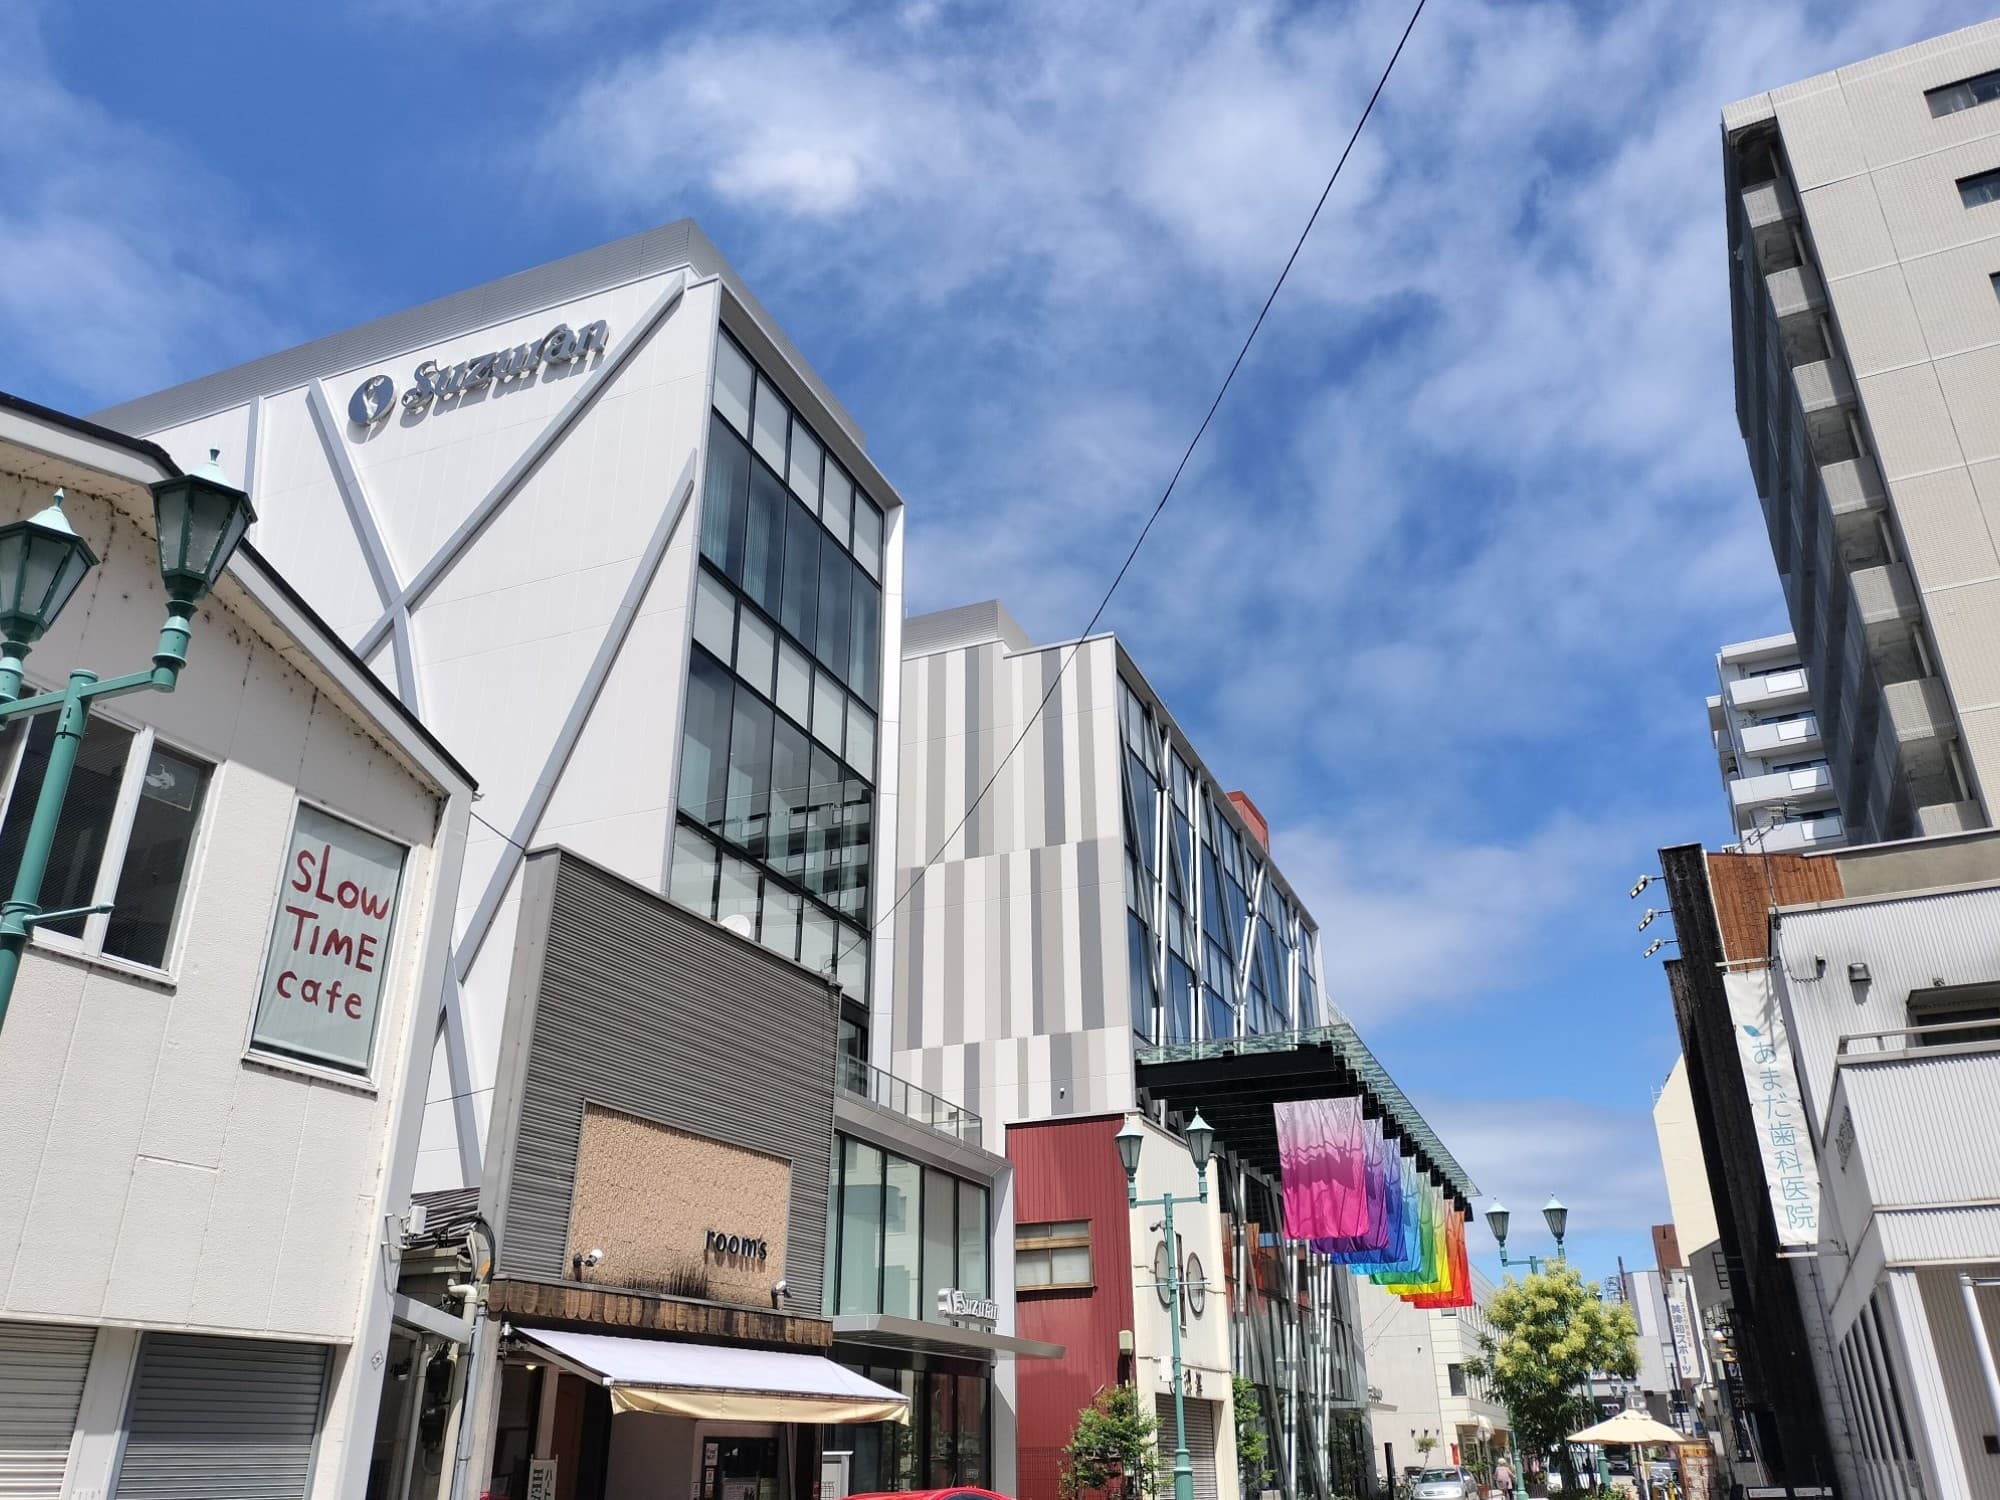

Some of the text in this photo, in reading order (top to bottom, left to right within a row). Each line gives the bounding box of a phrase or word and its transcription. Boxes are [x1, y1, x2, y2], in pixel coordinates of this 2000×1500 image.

[401, 319, 610, 412] Suzuran
[285, 905, 378, 973] TIME
[276, 970, 363, 1020] cafe
[1751, 1040, 1818, 1231] あまだ歯科医院
